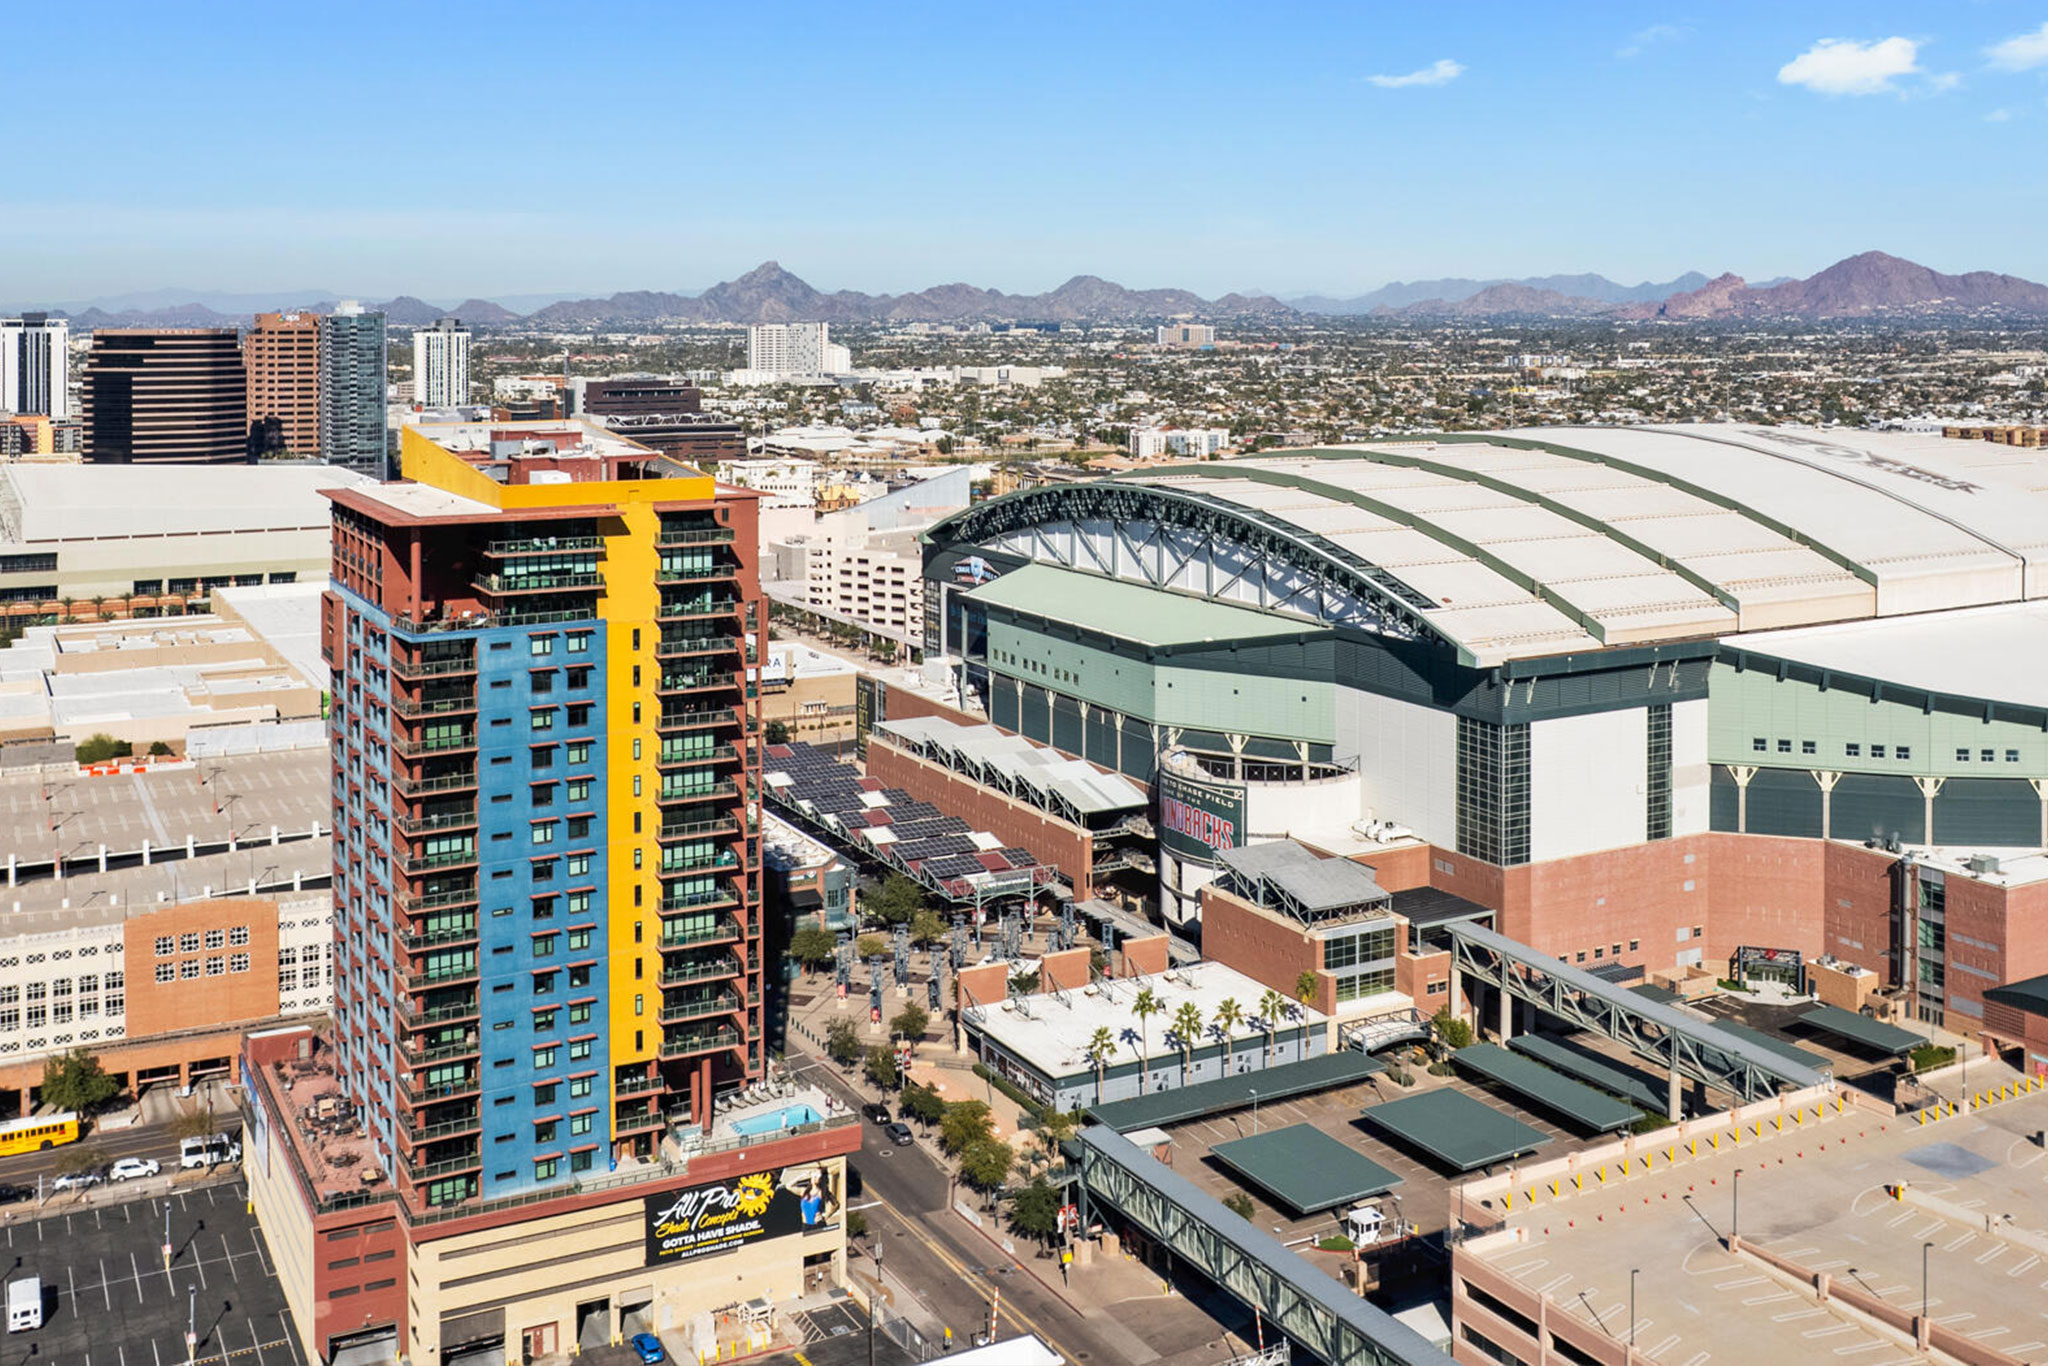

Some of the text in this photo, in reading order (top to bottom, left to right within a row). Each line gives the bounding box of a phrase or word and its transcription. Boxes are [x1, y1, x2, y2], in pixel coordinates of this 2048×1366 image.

[1178, 783, 1203, 798] CHASE
[1206, 793, 1234, 808] FIELD
[653, 1186, 741, 1231] All Pro
[698, 1209, 739, 1228] Concepts
[662, 1220, 761, 1249] GOTTA HAVE SHADE.
[681, 1238, 744, 1258] ALLPROSHADE.COM
